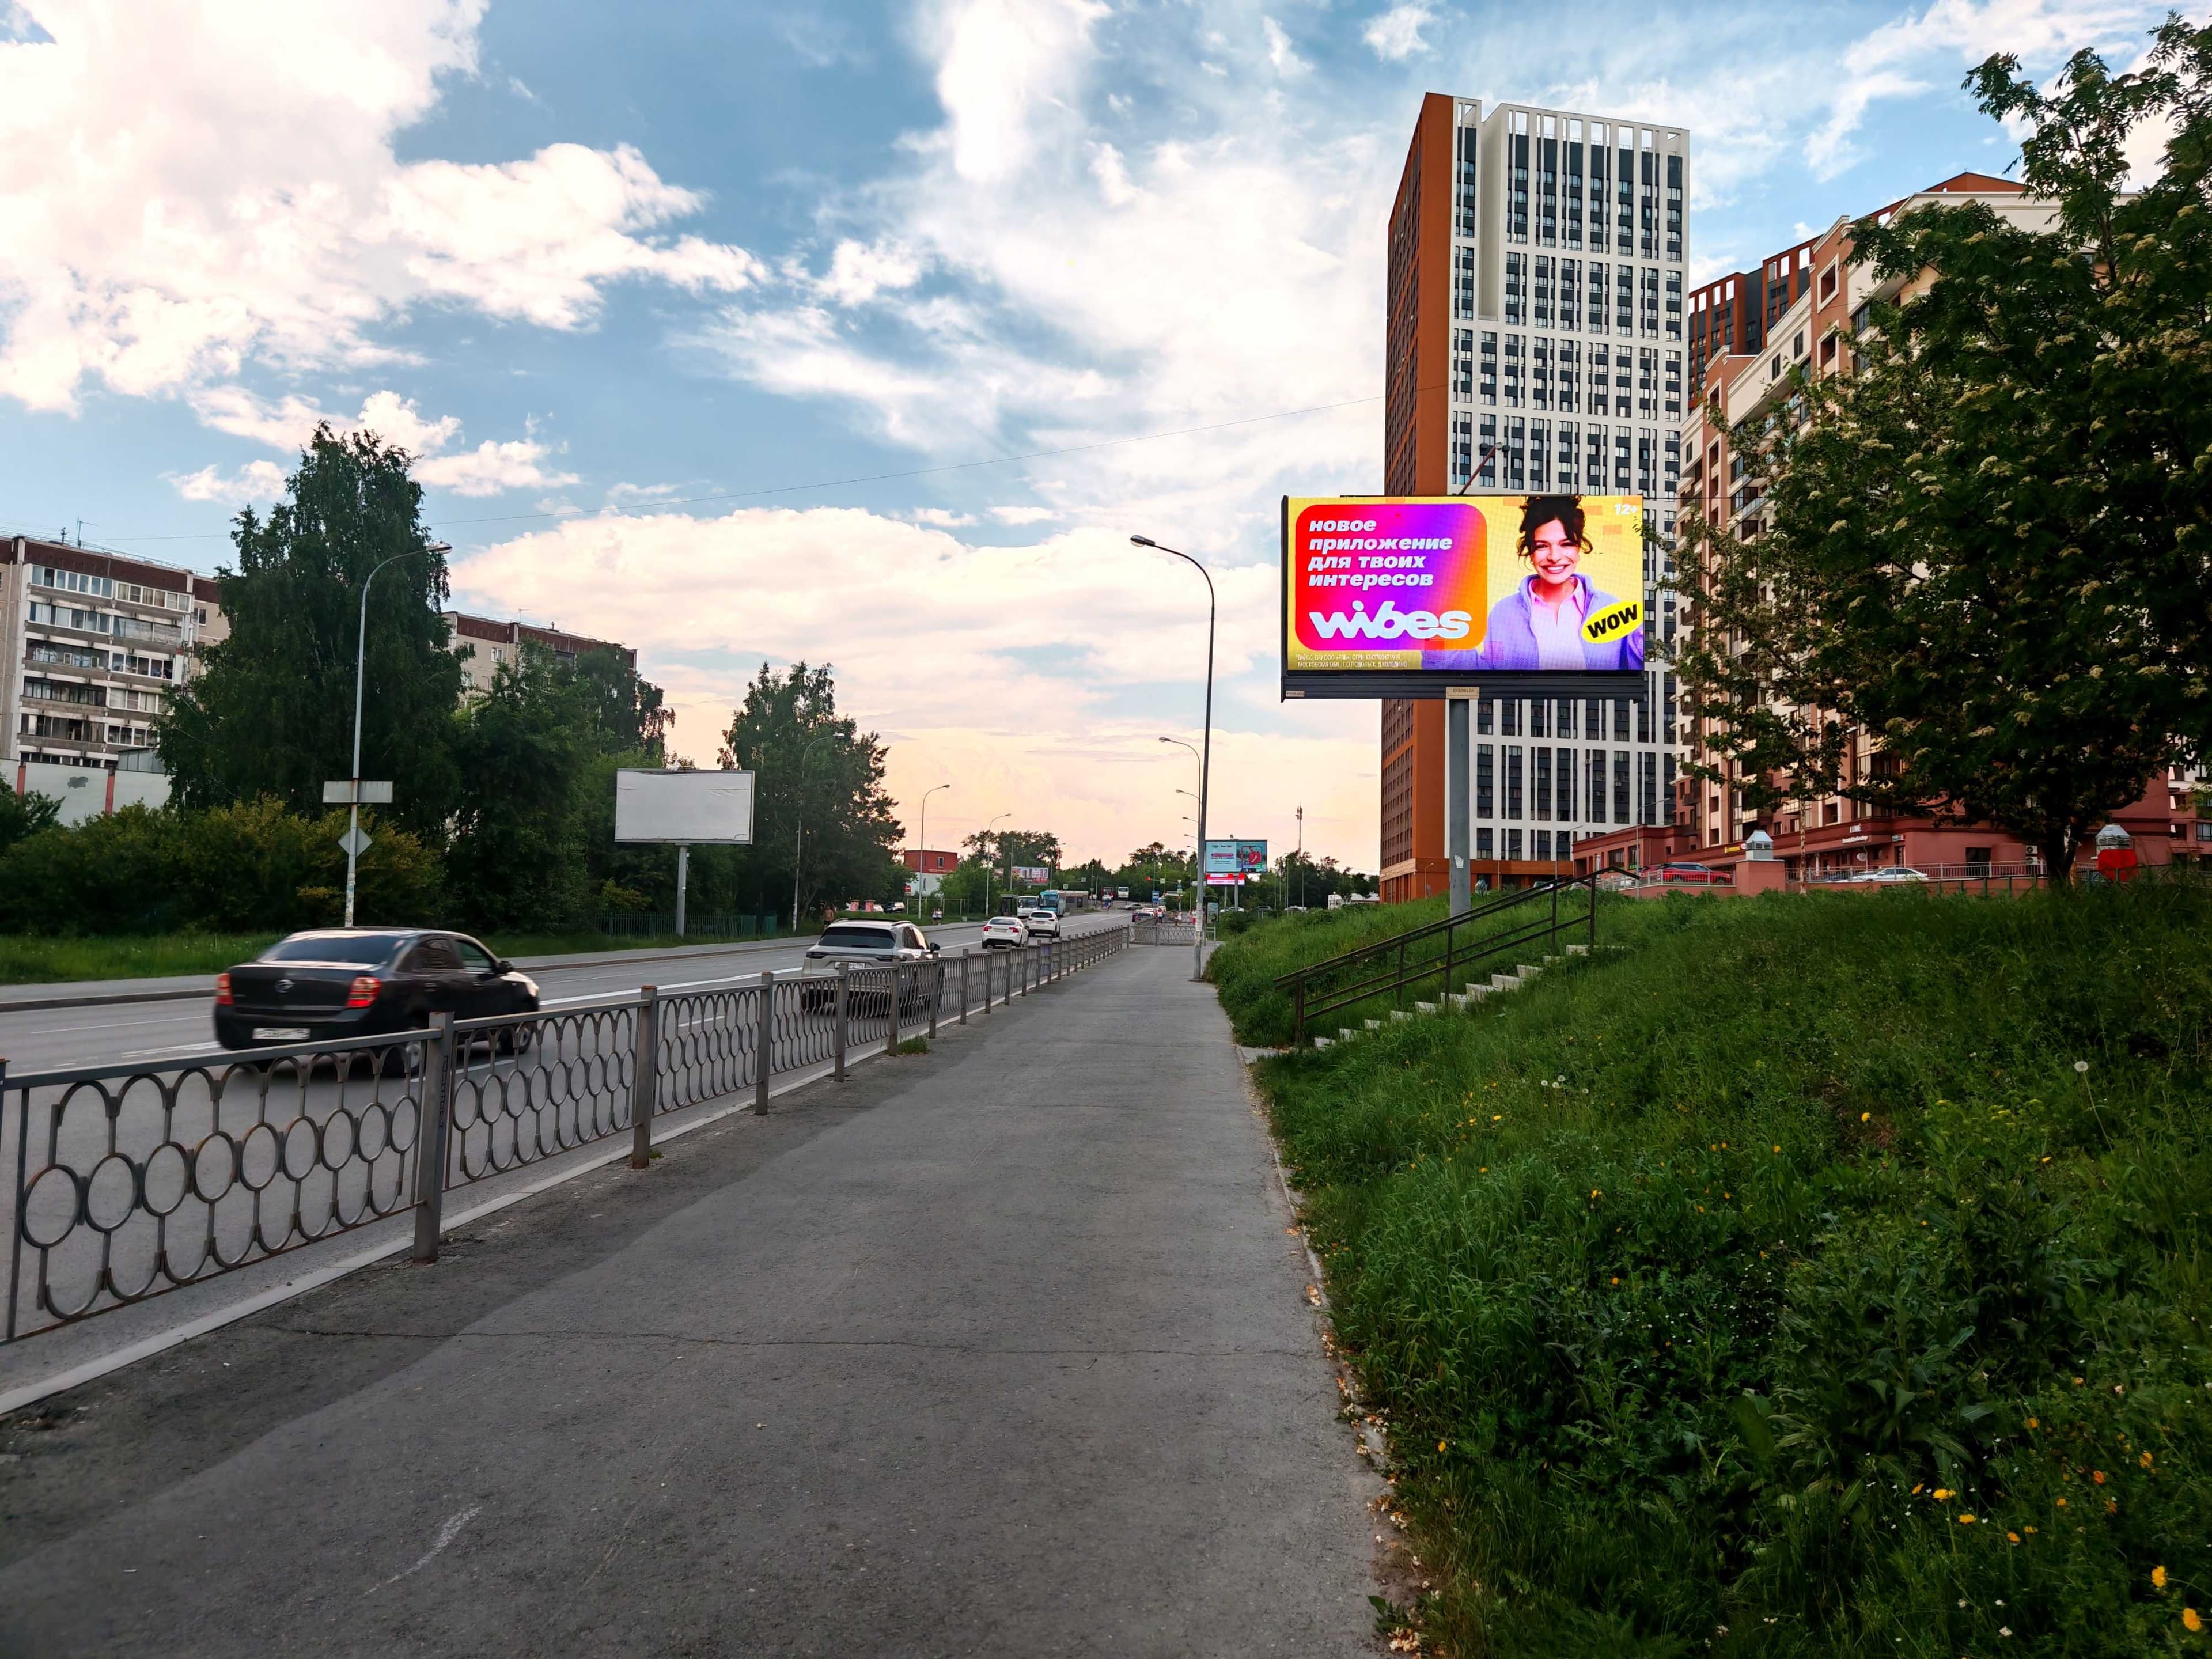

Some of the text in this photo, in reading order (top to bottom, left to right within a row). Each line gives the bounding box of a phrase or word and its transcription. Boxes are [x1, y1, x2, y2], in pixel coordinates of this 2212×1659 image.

[1614, 504, 1638, 516] 12+
[1309, 520, 1377, 532] новое
[1309, 537, 1453, 555] приложение
[1308, 556, 1427, 571] для твоих
[1308, 574, 1434, 591] интересов
[1308, 600, 1472, 639] wibes
